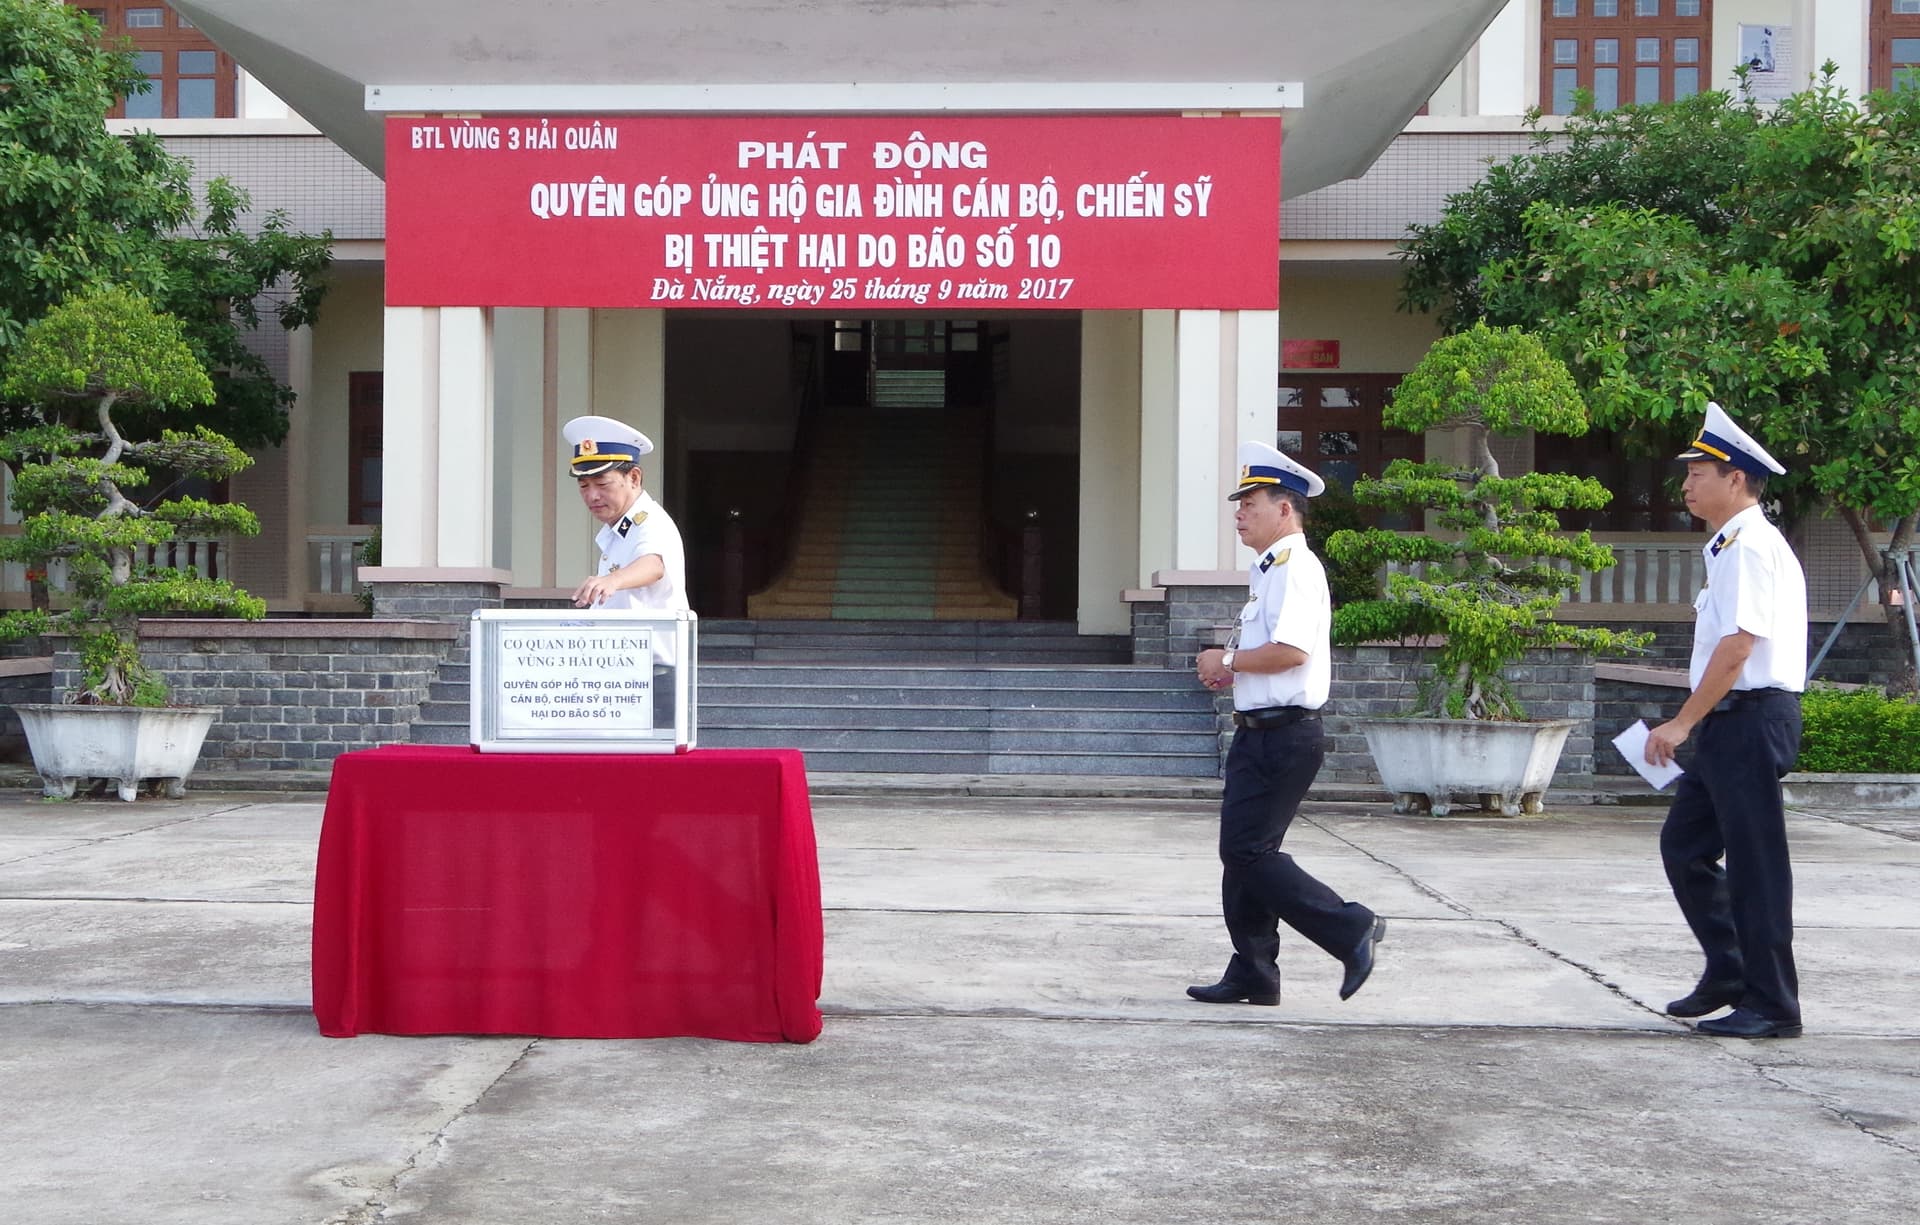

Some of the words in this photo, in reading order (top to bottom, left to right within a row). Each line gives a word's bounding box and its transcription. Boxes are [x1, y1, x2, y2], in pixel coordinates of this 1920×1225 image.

[411, 127, 445, 149] BTL
[450, 119, 500, 150] VÙNG
[508, 127, 520, 150] 3
[526, 118, 557, 150] HẢI
[565, 120, 618, 150] QUÂN
[738, 130, 848, 169] PHÁT
[872, 130, 988, 179] ĐỘNG
[530, 175, 626, 220] QUYÊN
[634, 175, 692, 217] GÓP
[701, 172, 760, 218] ỦNG
[769, 175, 808, 224] HỘ
[815, 183, 863, 218] GIA
[872, 176, 944, 218] ĐÌNH
[952, 176, 1011, 218] CÁN
[1018, 175, 1065, 225] BỘ,
[1076, 170, 1165, 218] CHIẾN
[1173, 174, 1214, 218] SỸ
[665, 233, 694, 275] BỊ
[703, 224, 789, 275] THIỆT
[798, 233, 846, 274] HẠI
[857, 233, 897, 268] DO
[907, 225, 966, 268] BÃO
[975, 222, 1018, 268] SỐ
[1026, 233, 1061, 268] 10
[650, 276, 685, 301] Đà
[690, 274, 761, 306] Nẵng,
[767, 278, 825, 306] ngày
[829, 277, 859, 300] 25
[864, 275, 932, 306] tháng
[937, 277, 953, 301] 9
[956, 276, 1009, 301] năm
[1016, 277, 1076, 301] 2017
[526, 639, 564, 651] QUAN
[568, 636, 587, 652] BỘ
[590, 638, 610, 650] TƯ
[611, 636, 648, 652] LỆNH
[518, 654, 555, 667] VÙNG
[558, 656, 566, 667] 3
[596, 653, 635, 669] QUÂN
[503, 679, 538, 690] QUYÊN
[540, 678, 562, 689] GÓP
[564, 677, 579, 689] HỖ
[581, 679, 602, 691] TRỢ
[604, 681, 622, 689] GIA
[510, 693, 532, 704] CÁN
[534, 694, 551, 706] BỘ,
[553, 691, 584, 704] CHIẾN
[586, 693, 600, 704] SỸ
[602, 695, 612, 706] BỊ
[615, 693, 643, 706] THIỆT
[531, 709, 549, 720] HẠI
[551, 709, 566, 718] DO
[568, 707, 590, 718] BÃO
[592, 706, 607, 718] SỐ
[610, 709, 622, 718] 10
